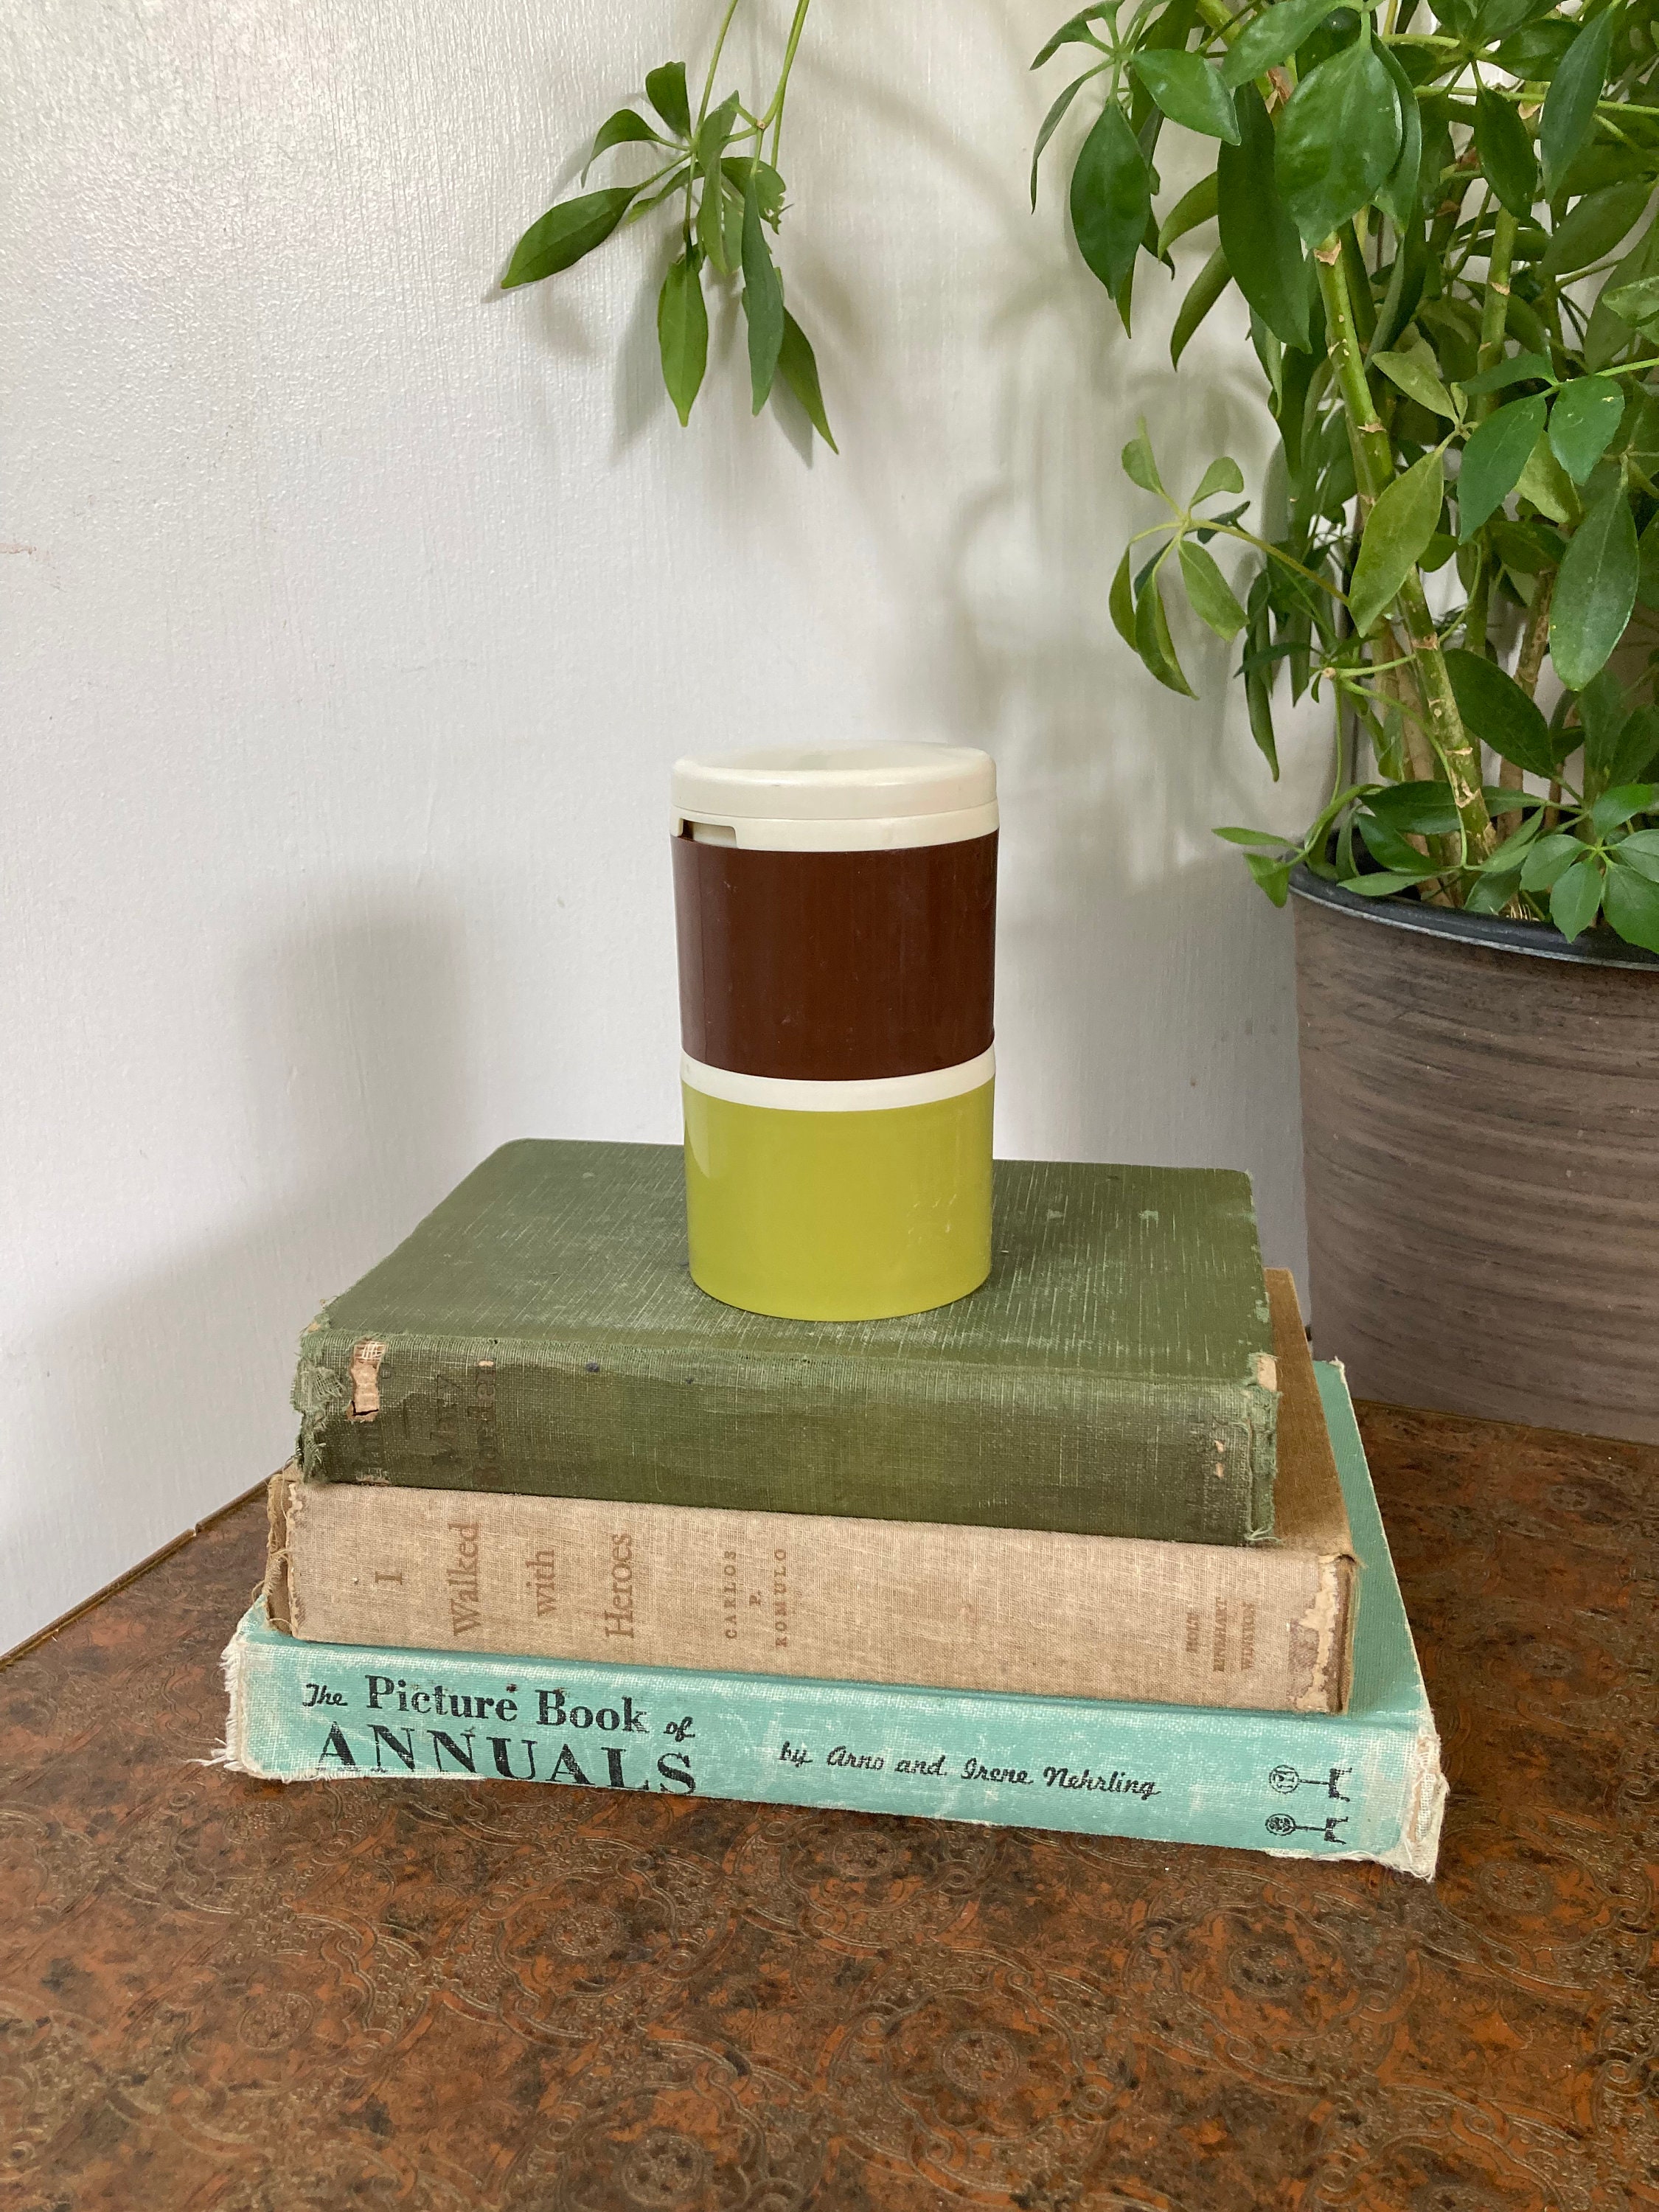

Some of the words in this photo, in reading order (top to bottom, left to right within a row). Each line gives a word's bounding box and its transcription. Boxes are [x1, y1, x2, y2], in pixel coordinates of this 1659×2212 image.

[375, 1567, 403, 1586] I
[448, 1522, 481, 1636] Walked
[526, 1548, 555, 1617] with
[605, 1532, 636, 1638] Heroes
[724, 1550, 737, 1639] CARLOS
[749, 1590, 762, 1607] P.
[774, 1548, 787, 1649] ROMULO
[302, 1683, 348, 1708] The
[364, 1674, 518, 1721] Picture
[535, 1689, 649, 1733] Book
[663, 1716, 696, 1742] of
[316, 1721, 696, 1795] ANNUALS
[779, 1741, 812, 1767] by
[827, 1745, 884, 1772] Arno
[894, 1753, 947, 1778] and
[961, 1756, 1034, 1785] Irene
[1043, 1765, 1161, 1798] Nehrling
